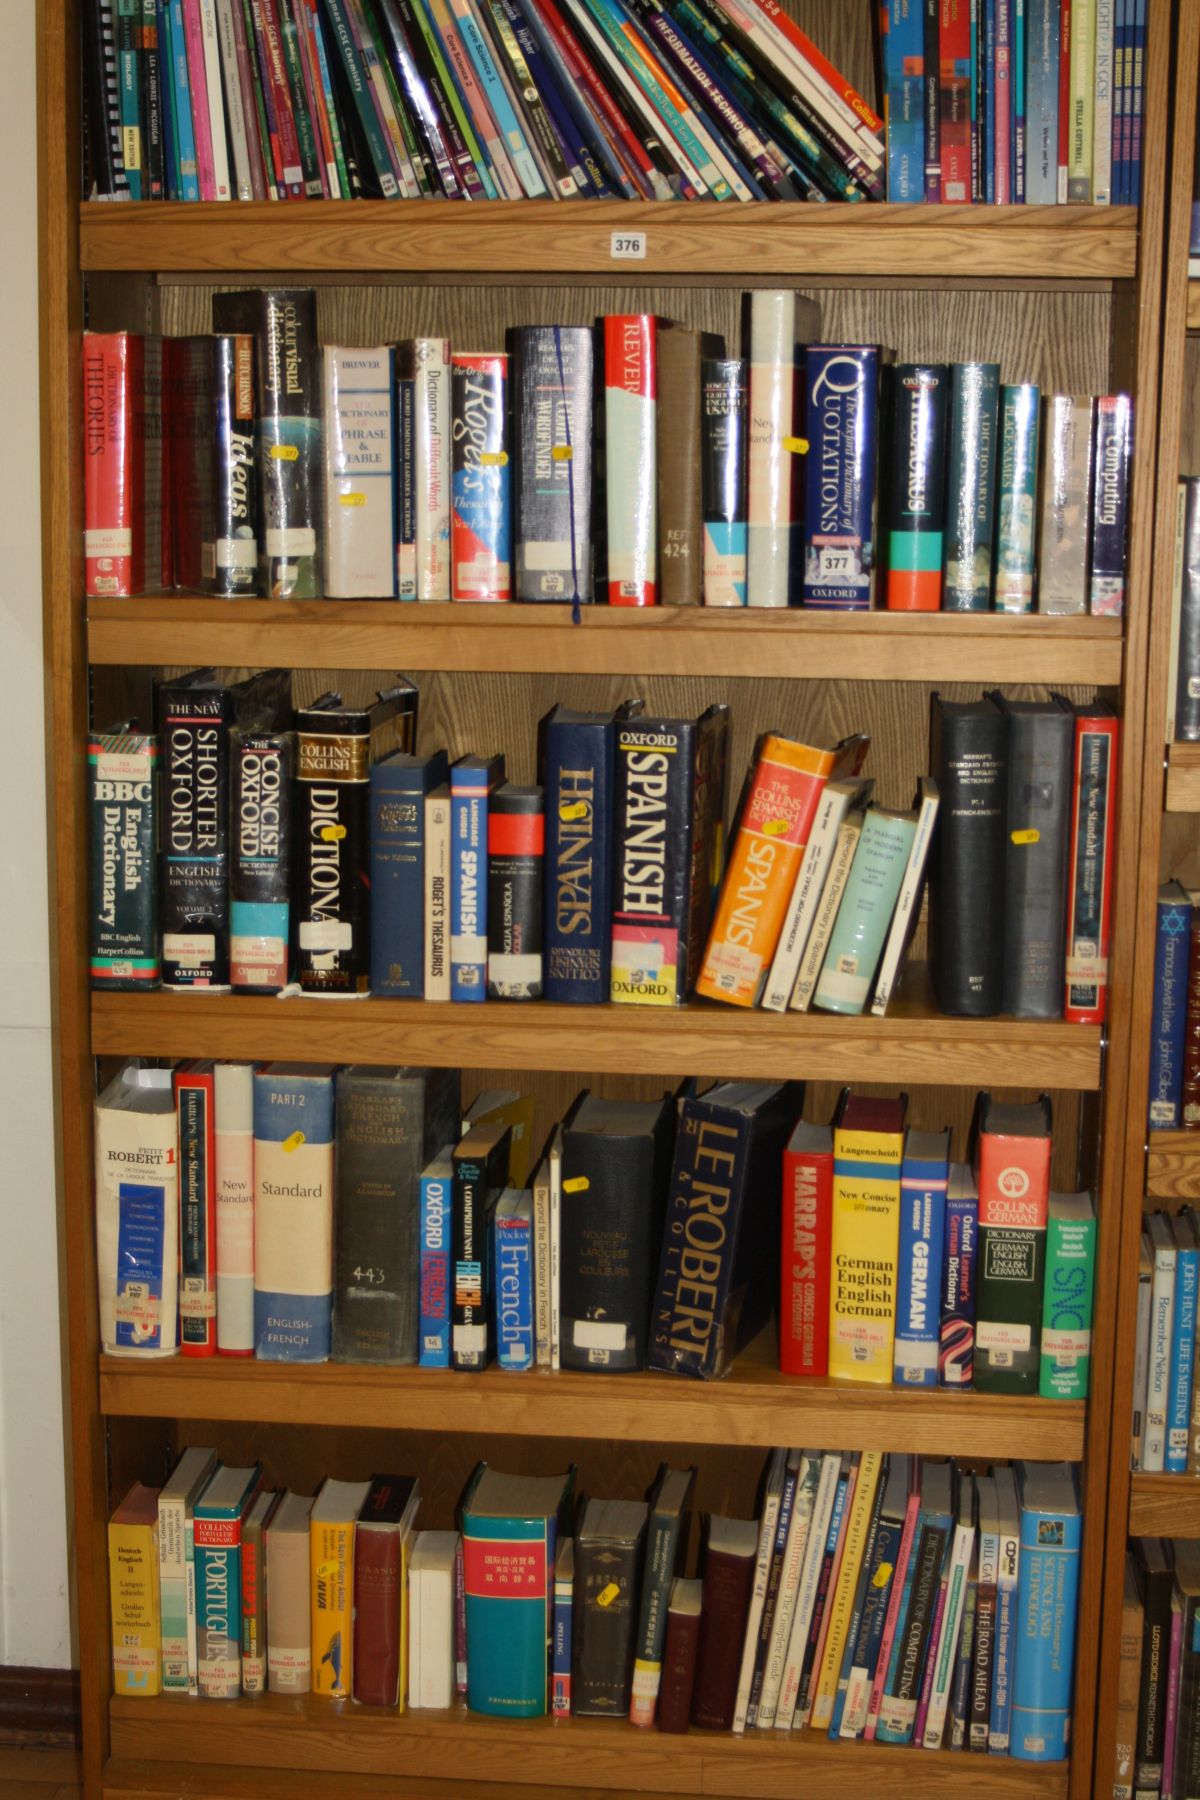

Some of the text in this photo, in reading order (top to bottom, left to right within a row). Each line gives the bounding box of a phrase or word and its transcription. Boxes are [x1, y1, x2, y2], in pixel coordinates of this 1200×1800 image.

[999, 5, 1008, 42] MATHS
[447, 34, 469, 80] Core Science
[468, 24, 491, 75] Core Science
[517, 30, 536, 55] Higher
[655, 18, 712, 88] INFORMATION
[338, 24, 363, 92] GCSE Chemistry
[928, 77, 936, 104] Complete
[852, 99, 877, 128] Collins
[585, 158, 604, 188] Collins
[615, 239, 641, 252] 376
[286, 355, 303, 395] visual
[342, 360, 387, 370] BREWER
[240, 349, 251, 416] HUTCHINSON
[86, 352, 105, 457] THEORIES
[341, 430, 387, 440] PHRASE
[358, 441, 369, 451] &
[427, 369, 443, 512] Dictionary Difficult Words
[812, 355, 862, 534] QUOTATIONS
[1002, 404, 1015, 489] PLACE-NAMES
[346, 453, 382, 464] FABLE
[908, 391, 926, 513] THESAURUS
[230, 430, 254, 520] Ideas
[844, 452, 857, 516] Dictionary
[977, 421, 991, 522] DICTIONARY OF
[1099, 434, 1122, 525] Computing
[667, 529, 689, 540] REF
[663, 545, 691, 558] 424
[824, 557, 849, 569] 377
[812, 588, 858, 599] OXFORD
[169, 704, 220, 715] THE NEW
[300, 744, 351, 759] COLLINS
[620, 732, 678, 747] OXFORD
[300, 759, 351, 771] ENGLISH
[94, 781, 152, 802] BBC
[171, 728, 194, 852] OXFORD
[197, 728, 218, 851] SHORTER
[754, 787, 802, 810] COLLINS
[240, 754, 261, 857] OXFORD
[260, 754, 281, 857] CONCISE
[460, 806, 468, 838] GUIDES
[470, 799, 479, 848] LANGUAGE
[623, 752, 669, 915] SPANISH
[1086, 787, 1099, 857] New Standard
[121, 806, 142, 892] English
[555, 766, 595, 936] SPANISH
[98, 805, 121, 928] Dictionary
[169, 866, 219, 877] ENGLISH
[240, 861, 279, 869] DICTIONARY
[170, 879, 218, 887] DICTIONARY
[432, 876, 445, 917] ROGET'S
[460, 850, 478, 938] SPANISH
[726, 839, 776, 952] SPANIS
[100, 933, 141, 943] BBC English
[806, 884, 840, 977] Dictionary Spanish
[97, 946, 145, 957] HarperCollins
[431, 920, 444, 978] THESAURUS
[174, 969, 213, 978] OXFORD
[612, 981, 668, 996] OXFORD
[271, 1093, 296, 1105] PART
[107, 1151, 164, 1165] ROBERT
[138, 1147, 163, 1155] PETIT
[839, 1144, 900, 1159] Langenscheidt
[189, 1139, 200, 1204] New Standard
[223, 1180, 247, 1191] New
[216, 1193, 255, 1204] Standard
[261, 1181, 322, 1198] Standard
[838, 1190, 898, 1204] New Concise
[426, 1183, 443, 1249] OXFORD
[793, 1165, 818, 1280] HARRAP'S
[987, 1200, 1039, 1215] COLLINS
[987, 1212, 1038, 1225] GERMAN
[669, 1120, 740, 1365] LE ROBERT
[962, 1215, 974, 1252] Oxford
[986, 1229, 1037, 1241] DICTIONARY
[991, 1242, 1030, 1253] GERMAN
[835, 1255, 894, 1273] German
[992, 1251, 1028, 1261] ENGLISH
[992, 1260, 1027, 1270] ENGLISH
[353, 1266, 385, 1283] 443
[430, 1251, 448, 1320] FRENCH
[836, 1270, 893, 1288] English
[909, 1241, 930, 1330] GERMAN
[944, 1257, 960, 1313] Dictionary
[990, 1268, 1029, 1278] GERMAN
[501, 1243, 533, 1343] French
[836, 1286, 893, 1305] English
[1180, 1262, 1195, 1330] JOHN HUNT
[267, 1317, 313, 1329] ENGLISH-
[834, 1301, 894, 1319] German
[267, 1333, 309, 1345] FRENCH
[1153, 1296, 1171, 1393] Remember Nelson
[1179, 1337, 1192, 1361] LIFE
[1175, 1373, 1189, 1425] MEETING
[781, 1481, 795, 1511] THIS
[835, 1486, 846, 1513] THIS
[199, 1523, 234, 1531] COLLINS
[199, 1537, 234, 1545] DICTIONARY
[760, 1523, 775, 1560] Internet
[864, 1517, 879, 1569] CYBERSPACE
[983, 1538, 995, 1560] BILL
[118, 1555, 143, 1564] Englisch
[826, 1506, 866, 1672] Complete Sightings Catalogue
[1041, 1556, 1056, 1609] SCIENCE
[769, 1522, 808, 1682] Multimedia The Complete Guide
[1026, 1556, 1042, 1640] TECHNOLOGY
[898, 1533, 942, 1701] DICTIONARY COMPUTING
[1051, 1604, 1066, 1657] Dictionary
[557, 1621, 565, 1655] SPELLING
[974, 1601, 992, 1713] THE ROAD AHEAD
[996, 1676, 1007, 1706] CD-ROM
